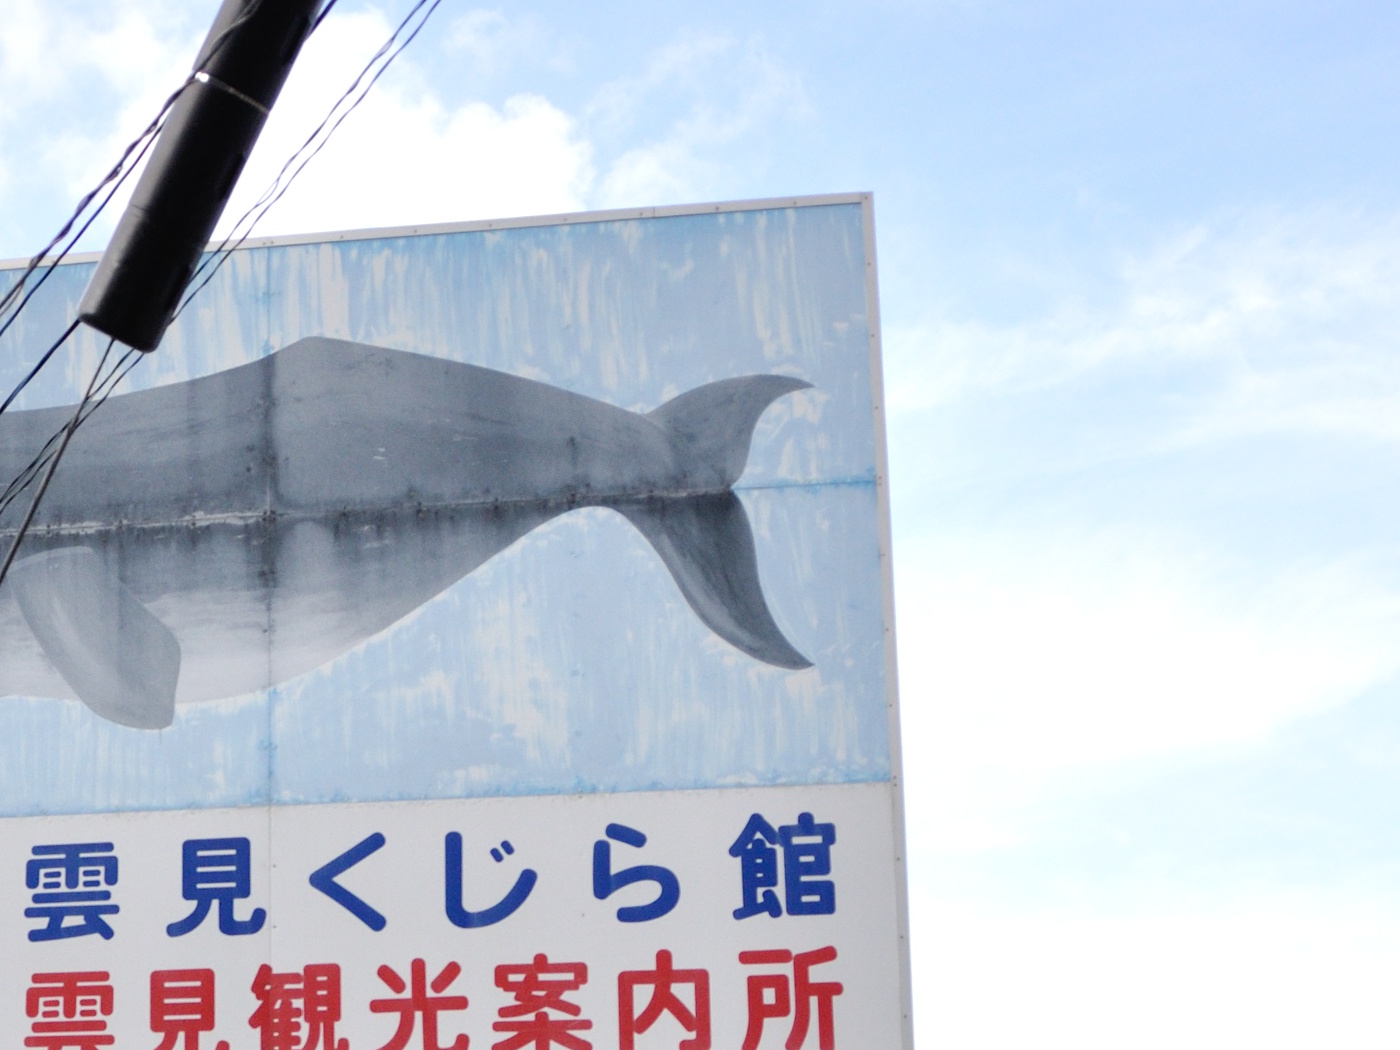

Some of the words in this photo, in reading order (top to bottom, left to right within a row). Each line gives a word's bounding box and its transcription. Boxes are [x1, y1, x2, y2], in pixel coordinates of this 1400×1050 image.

[24, 811, 838, 942] 雲見くじら館
